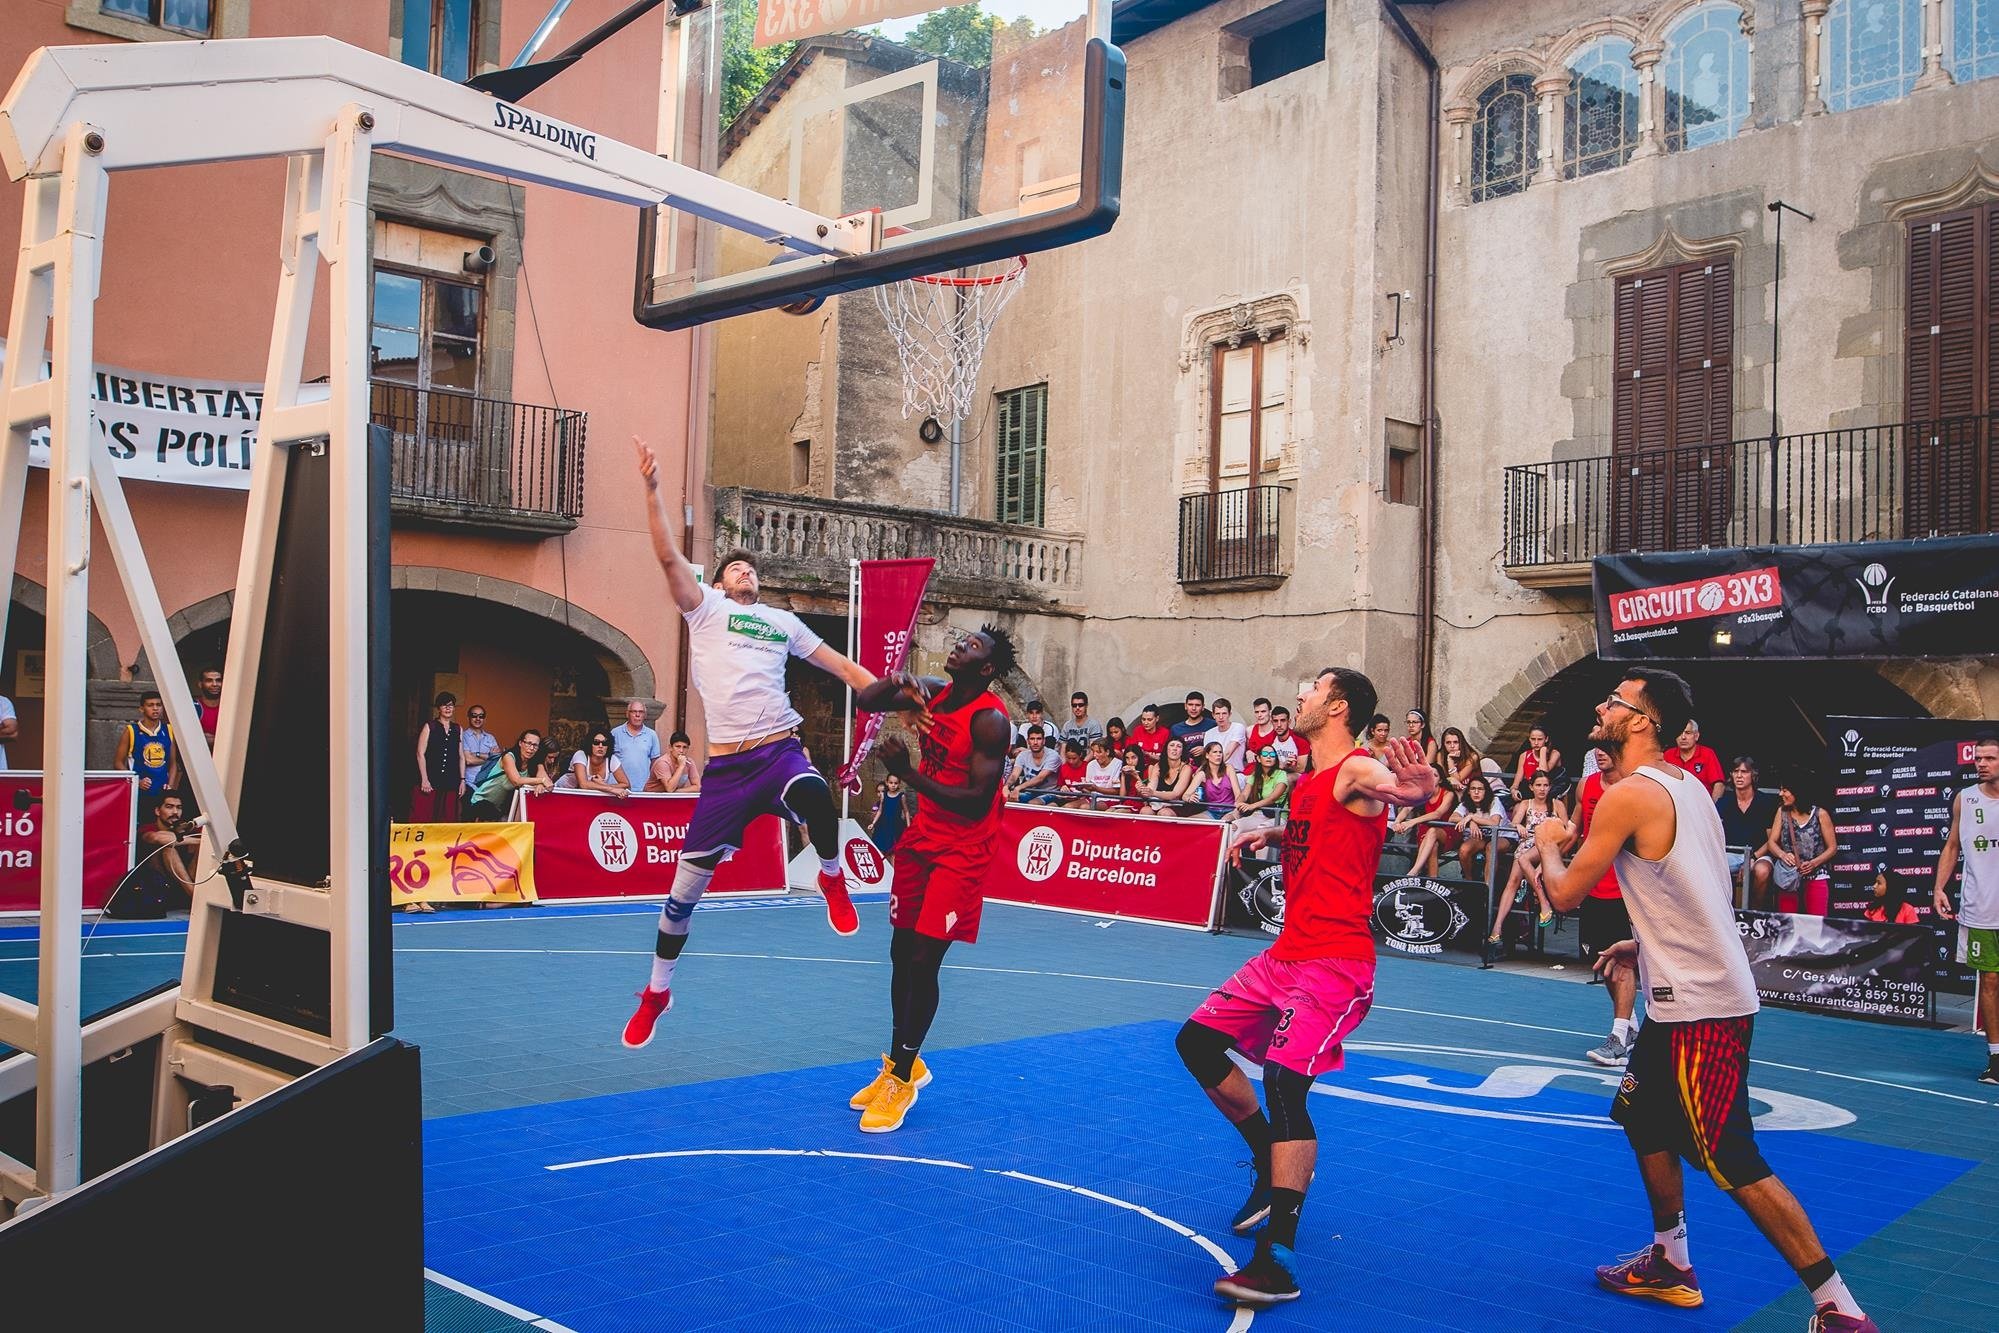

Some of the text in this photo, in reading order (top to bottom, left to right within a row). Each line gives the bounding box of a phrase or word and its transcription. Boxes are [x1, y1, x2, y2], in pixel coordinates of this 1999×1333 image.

[494, 102, 596, 161] SPALDING
[1618, 574, 1773, 624] CIRCUIT 3X3
[1900, 589, 1999, 602] Federació Catalana
[1900, 601, 1975, 613] de Basquetbol
[1737, 610, 1784, 624] #3x3basquet
[1975, 808, 1984, 824] 9
[1071, 838, 1161, 865] Diputació
[1067, 861, 1156, 887] Barcelona
[1382, 877, 1451, 898] BARBER SHOP
[1385, 937, 1442, 954] TONI IMATGE
[1971, 941, 1981, 957] 9
[1802, 971, 1825, 982] Ges
[1828, 974, 1858, 987] Avall,
[1863, 978, 1870, 987] 4
[1883, 979, 1925, 993] Torelló
[1845, 988, 1925, 1005] 93 859 51 92
